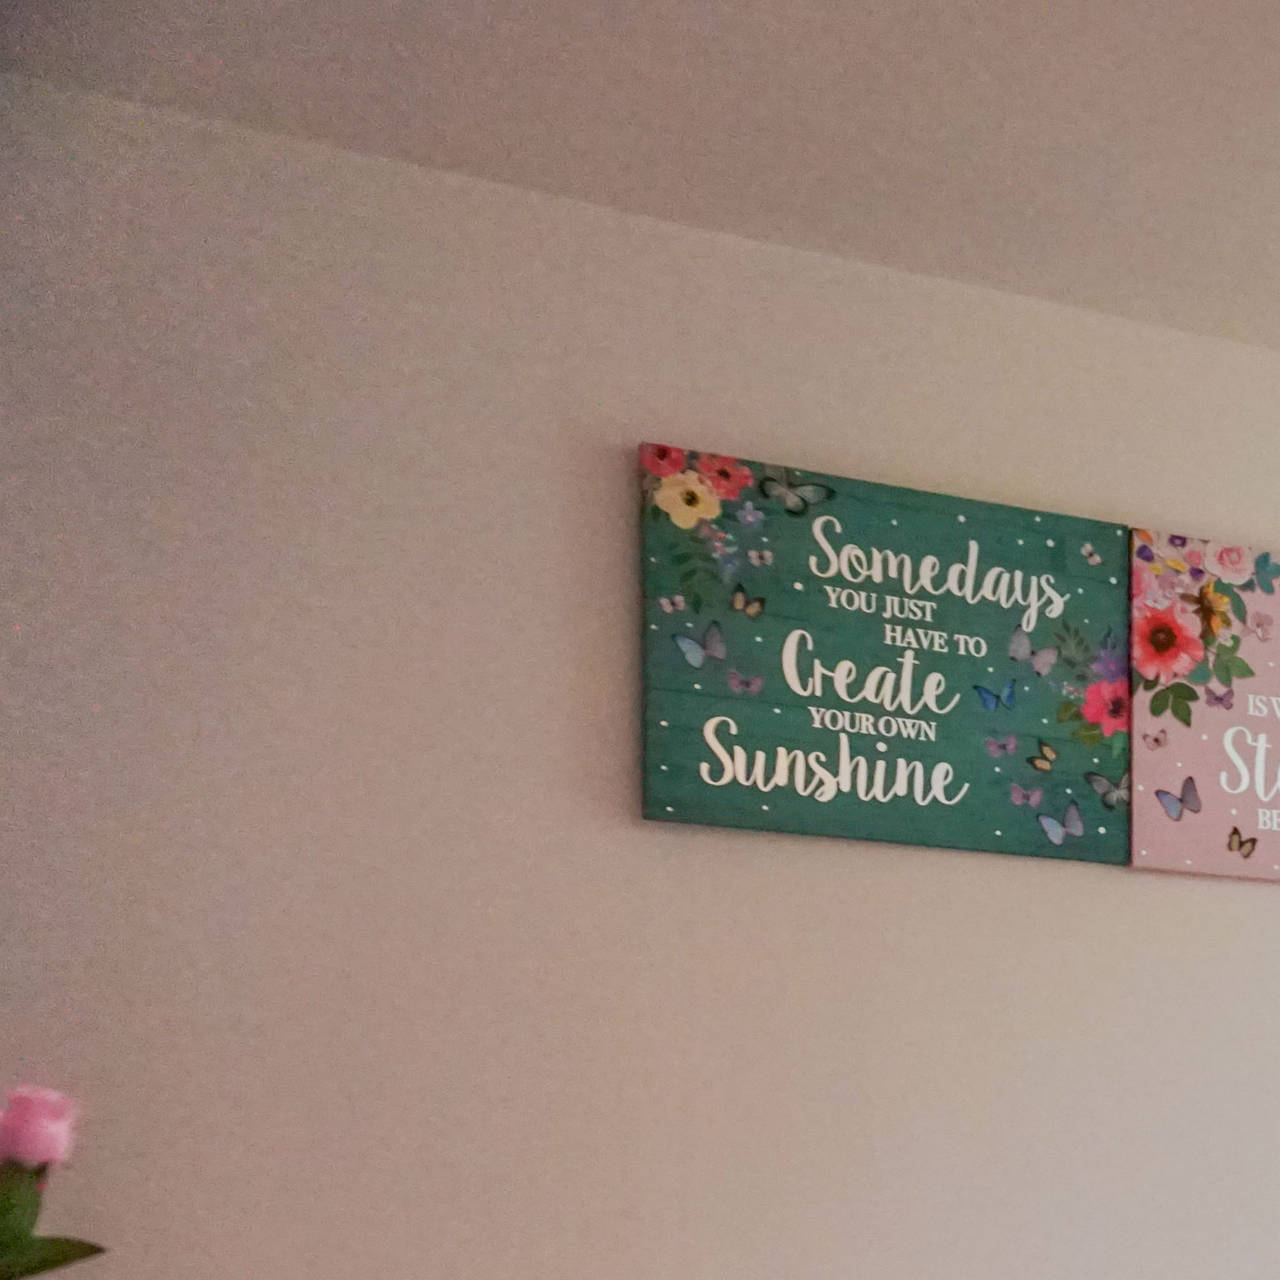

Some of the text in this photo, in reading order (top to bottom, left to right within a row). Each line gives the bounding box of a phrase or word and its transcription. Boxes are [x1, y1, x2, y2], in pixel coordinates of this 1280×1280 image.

[809, 515, 1071, 632] Somedays
[824, 585, 936, 622] YOU JUST
[884, 624, 987, 657] HAVE TO
[781, 629, 960, 715] Create
[808, 706, 936, 741] YOUR OWN
[1248, 694, 1267, 717] IS
[700, 716, 969, 806] Sunshine
